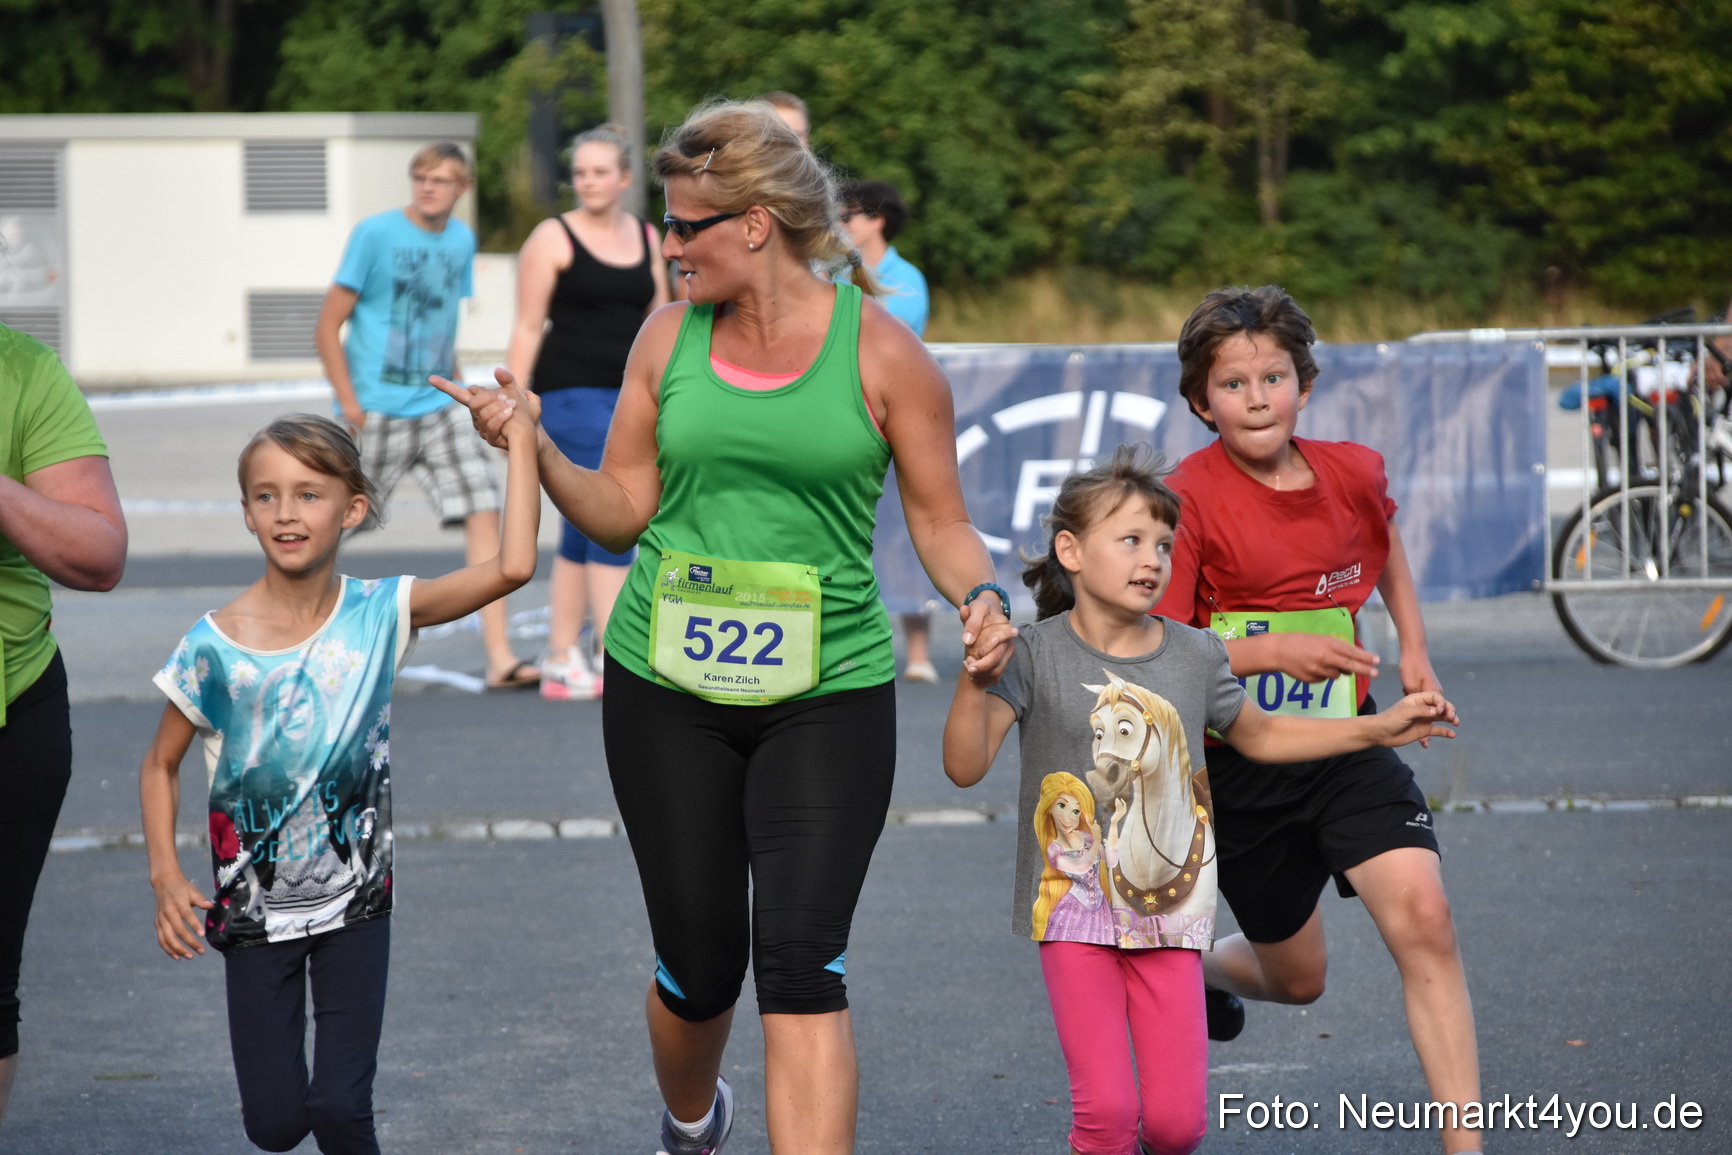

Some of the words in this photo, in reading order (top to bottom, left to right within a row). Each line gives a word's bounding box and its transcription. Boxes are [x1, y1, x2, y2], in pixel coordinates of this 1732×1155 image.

[677, 577, 735, 596] firmenlauf
[734, 591, 767, 603] 2015
[683, 615, 784, 666] 522
[703, 672, 734, 684] Karen
[735, 675, 761, 686] Zilch
[697, 683, 740, 693] Gesundheitsamt
[233, 780, 341, 833] ALWAYS
